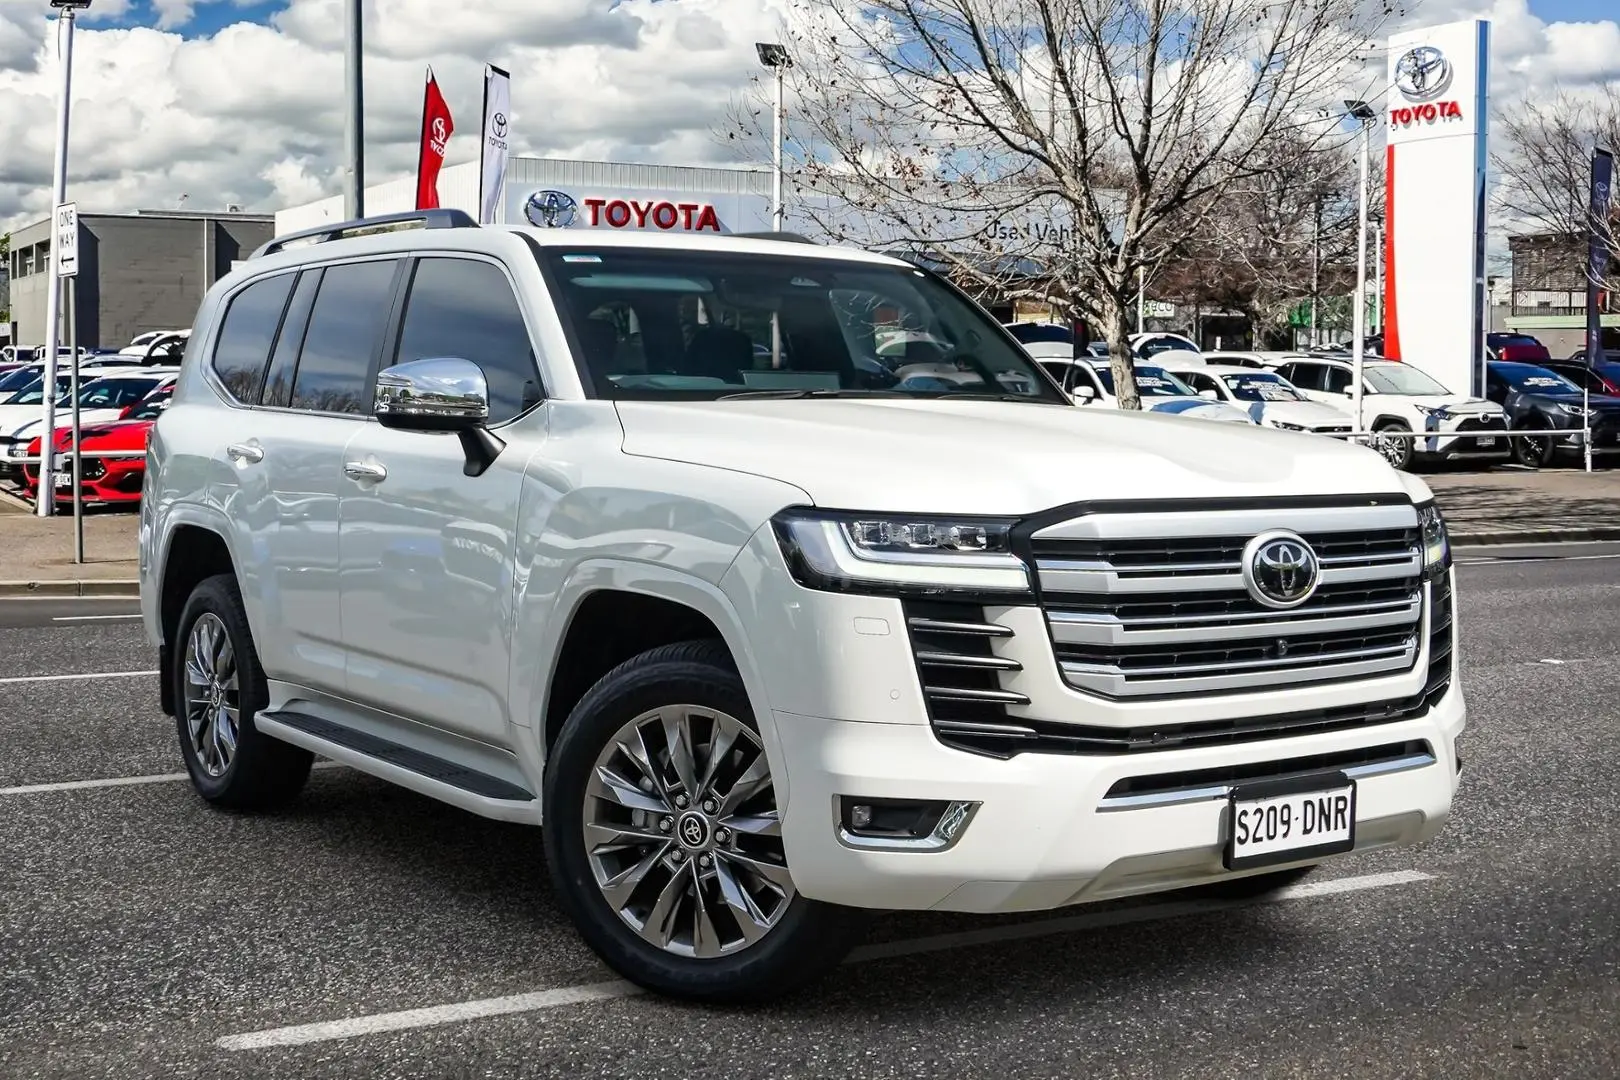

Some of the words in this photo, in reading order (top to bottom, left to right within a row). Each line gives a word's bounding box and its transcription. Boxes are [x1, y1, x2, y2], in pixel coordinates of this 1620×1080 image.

[1390, 101, 1461, 125] TOYOTA
[60, 210, 74, 227] ONE
[584, 198, 721, 232] TOYOTA
[60, 231, 75, 248] WAY
